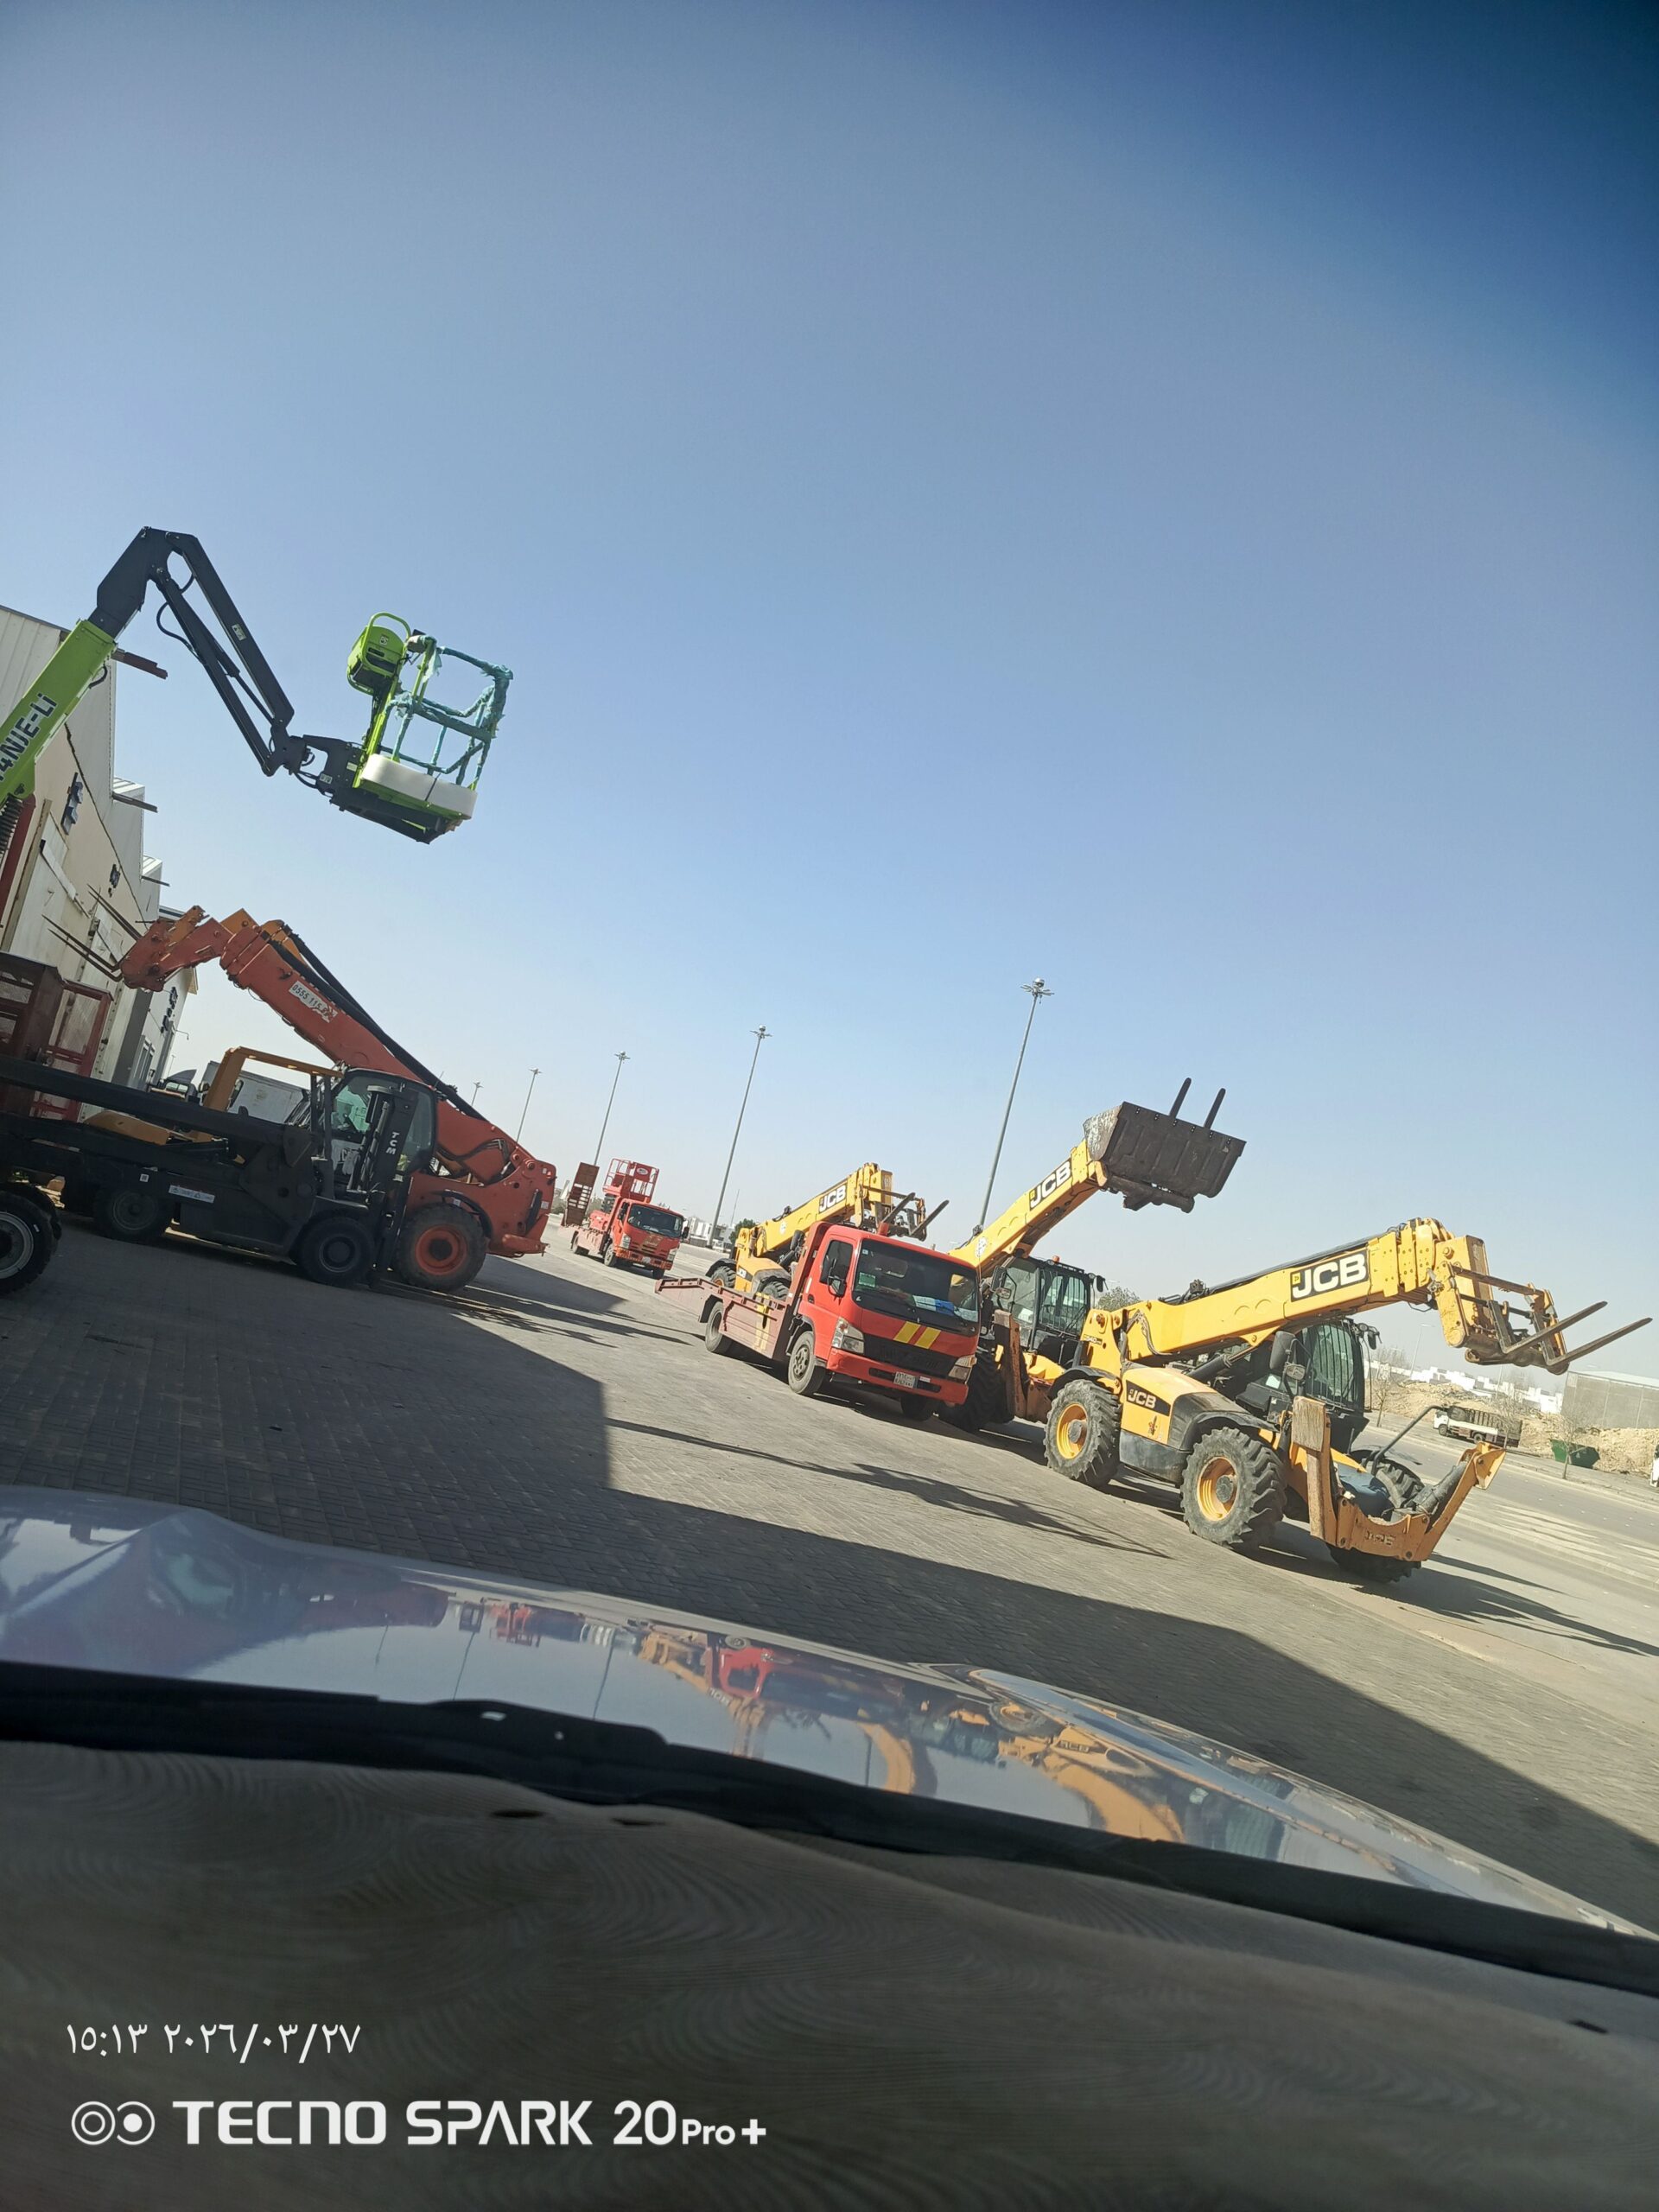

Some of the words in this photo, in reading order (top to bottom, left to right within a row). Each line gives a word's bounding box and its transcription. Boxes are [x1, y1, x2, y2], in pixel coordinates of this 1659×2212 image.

[291, 984, 310, 1000] 0555
[308, 997, 322, 1010] 115
[385, 1131, 400, 1155] TCM
[1029, 1160, 1071, 1209] JCB
[818, 1185, 847, 1212] JCB
[1292, 1253, 1367, 1299] JCB
[1128, 1389, 1157, 1409] JCB
